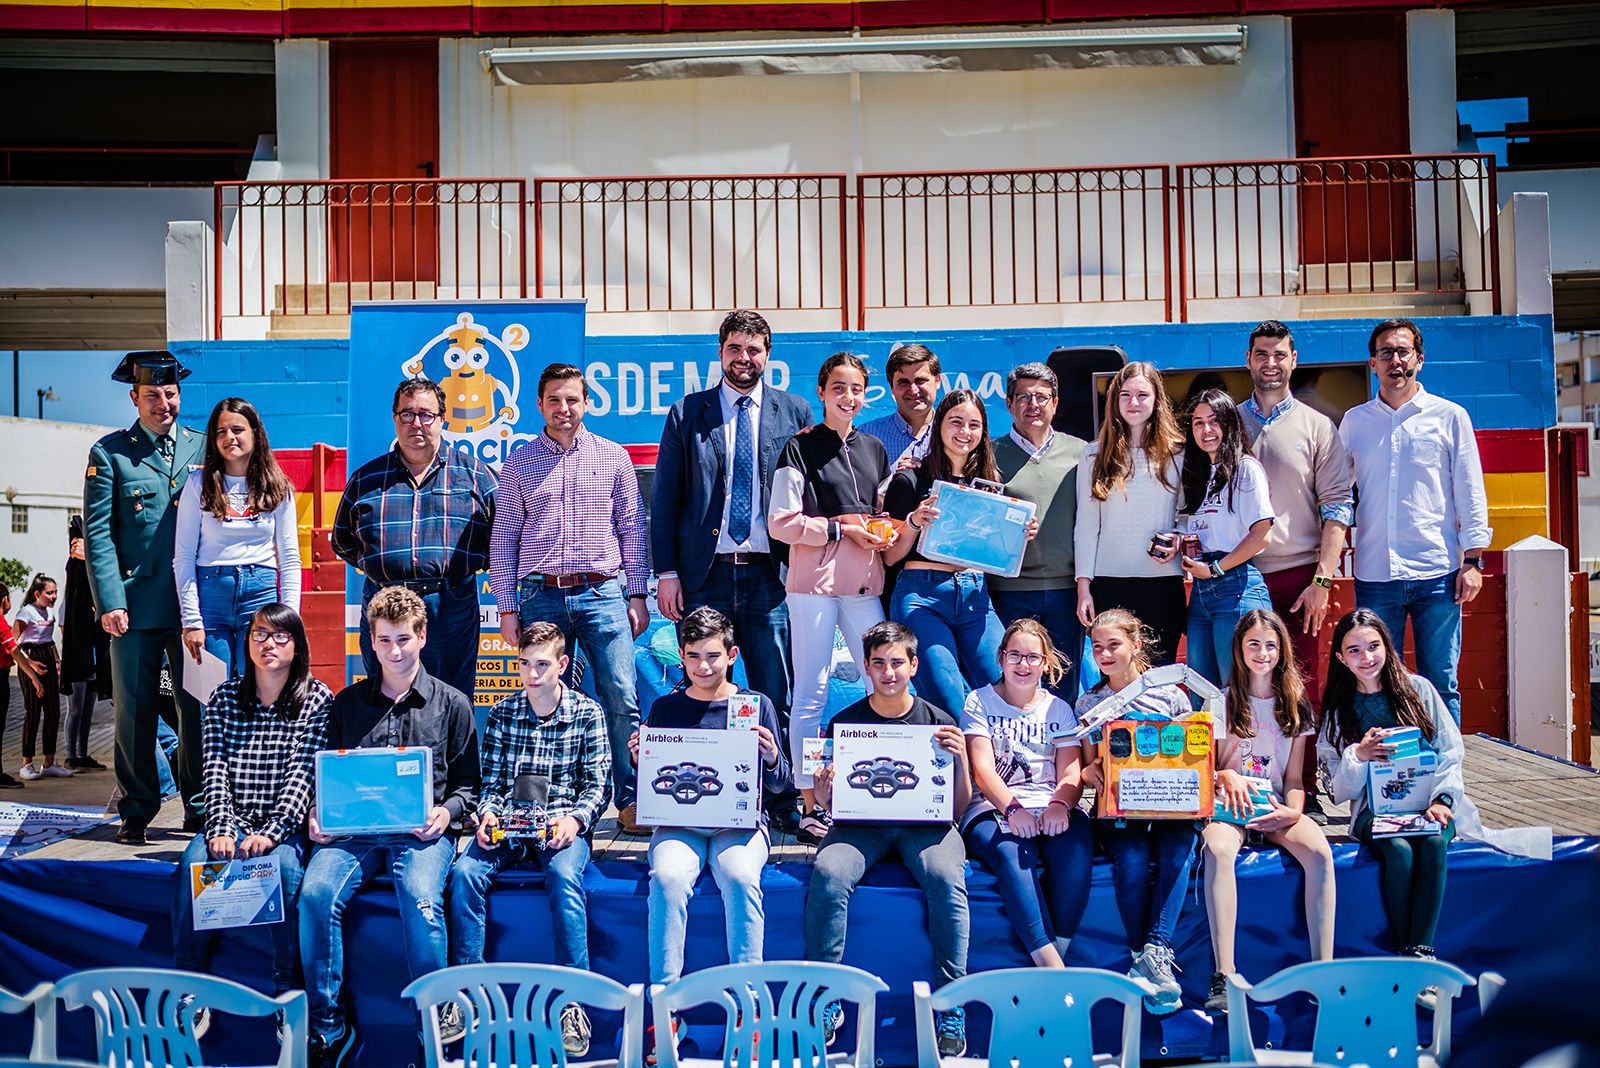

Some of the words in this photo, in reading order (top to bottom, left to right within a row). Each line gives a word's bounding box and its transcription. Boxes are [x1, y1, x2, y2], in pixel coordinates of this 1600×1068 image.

[509, 327, 523, 346] 2
[585, 360, 791, 416] SDEMR
[480, 639, 517, 651] GRA
[476, 662, 501, 671] ICOS
[474, 679, 496, 688] ERIA
[499, 680, 512, 688] DE
[474, 695, 490, 703] RES
[242, 862, 273, 872] DIPLOMA
